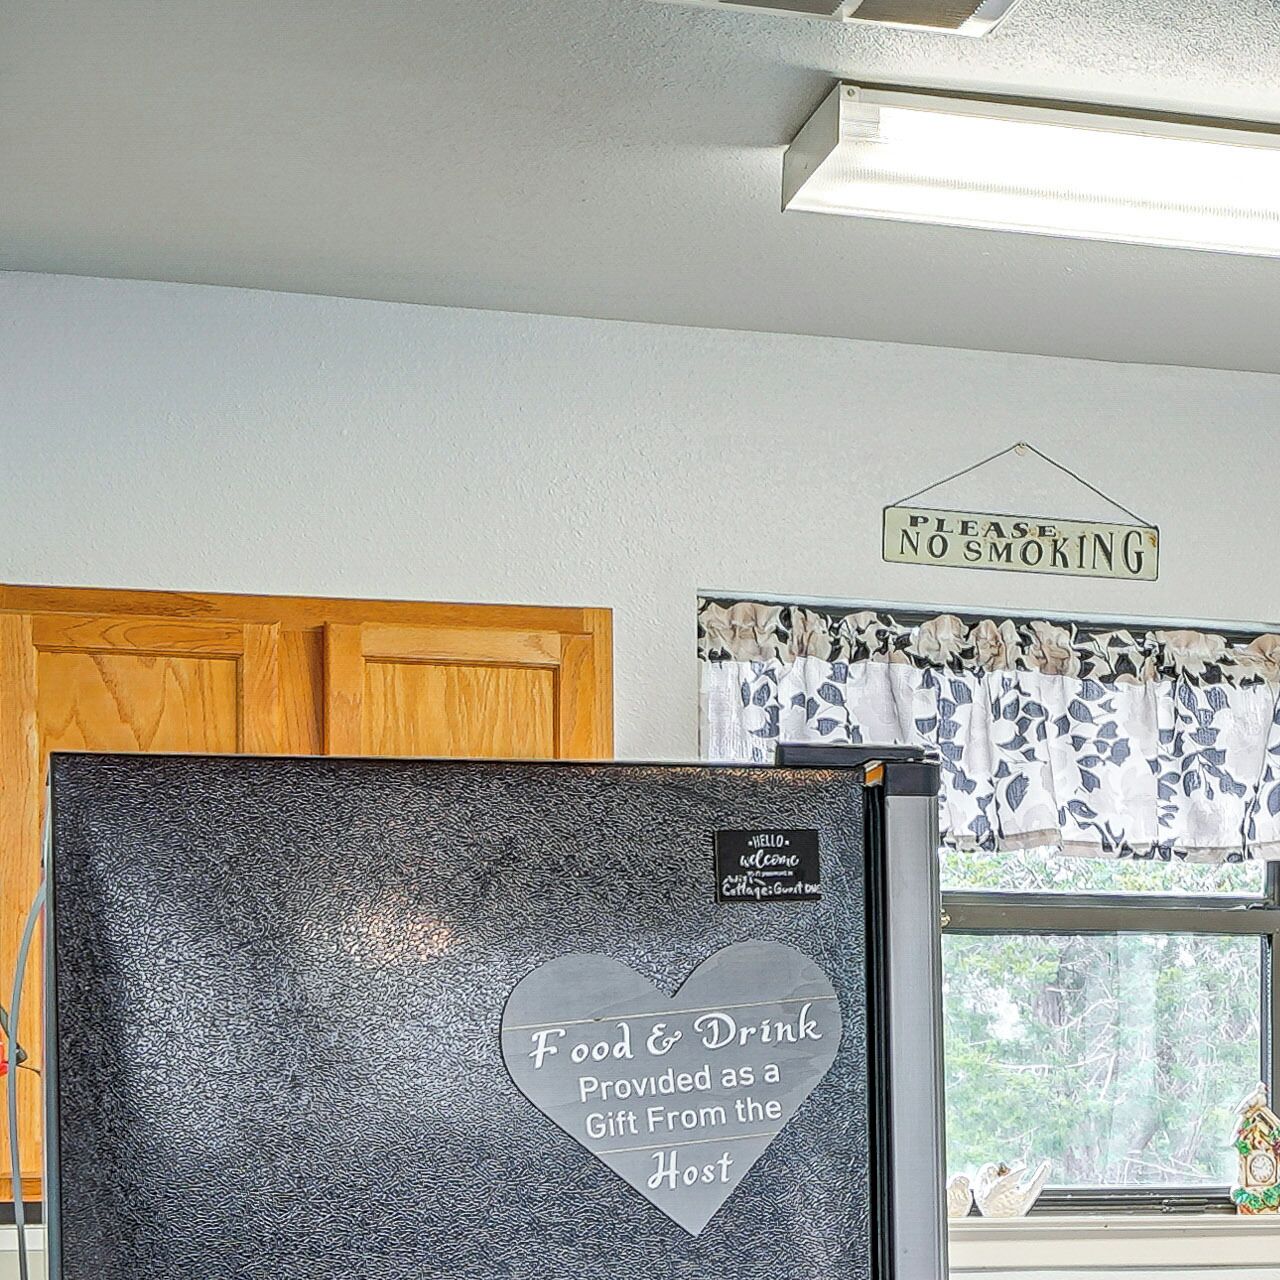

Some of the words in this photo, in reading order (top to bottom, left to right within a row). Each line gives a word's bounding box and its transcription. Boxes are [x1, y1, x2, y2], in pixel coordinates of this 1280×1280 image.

[908, 514, 1057, 539] PLEASE
[900, 529, 949, 559] NO
[963, 530, 1145, 575] SMOKING
[739, 849, 799, 869] welcome
[752, 834, 784, 849] HELLO
[528, 1022, 634, 1070] Food
[646, 1023, 683, 1056] &
[694, 1002, 823, 1049] Drink
[579, 1064, 712, 1103] Provided
[721, 1067, 754, 1088] as
[763, 1063, 781, 1083] a
[585, 1111, 638, 1139] Gift
[647, 1105, 727, 1132] From
[735, 1096, 782, 1123] the
[648, 1150, 734, 1191] Host
